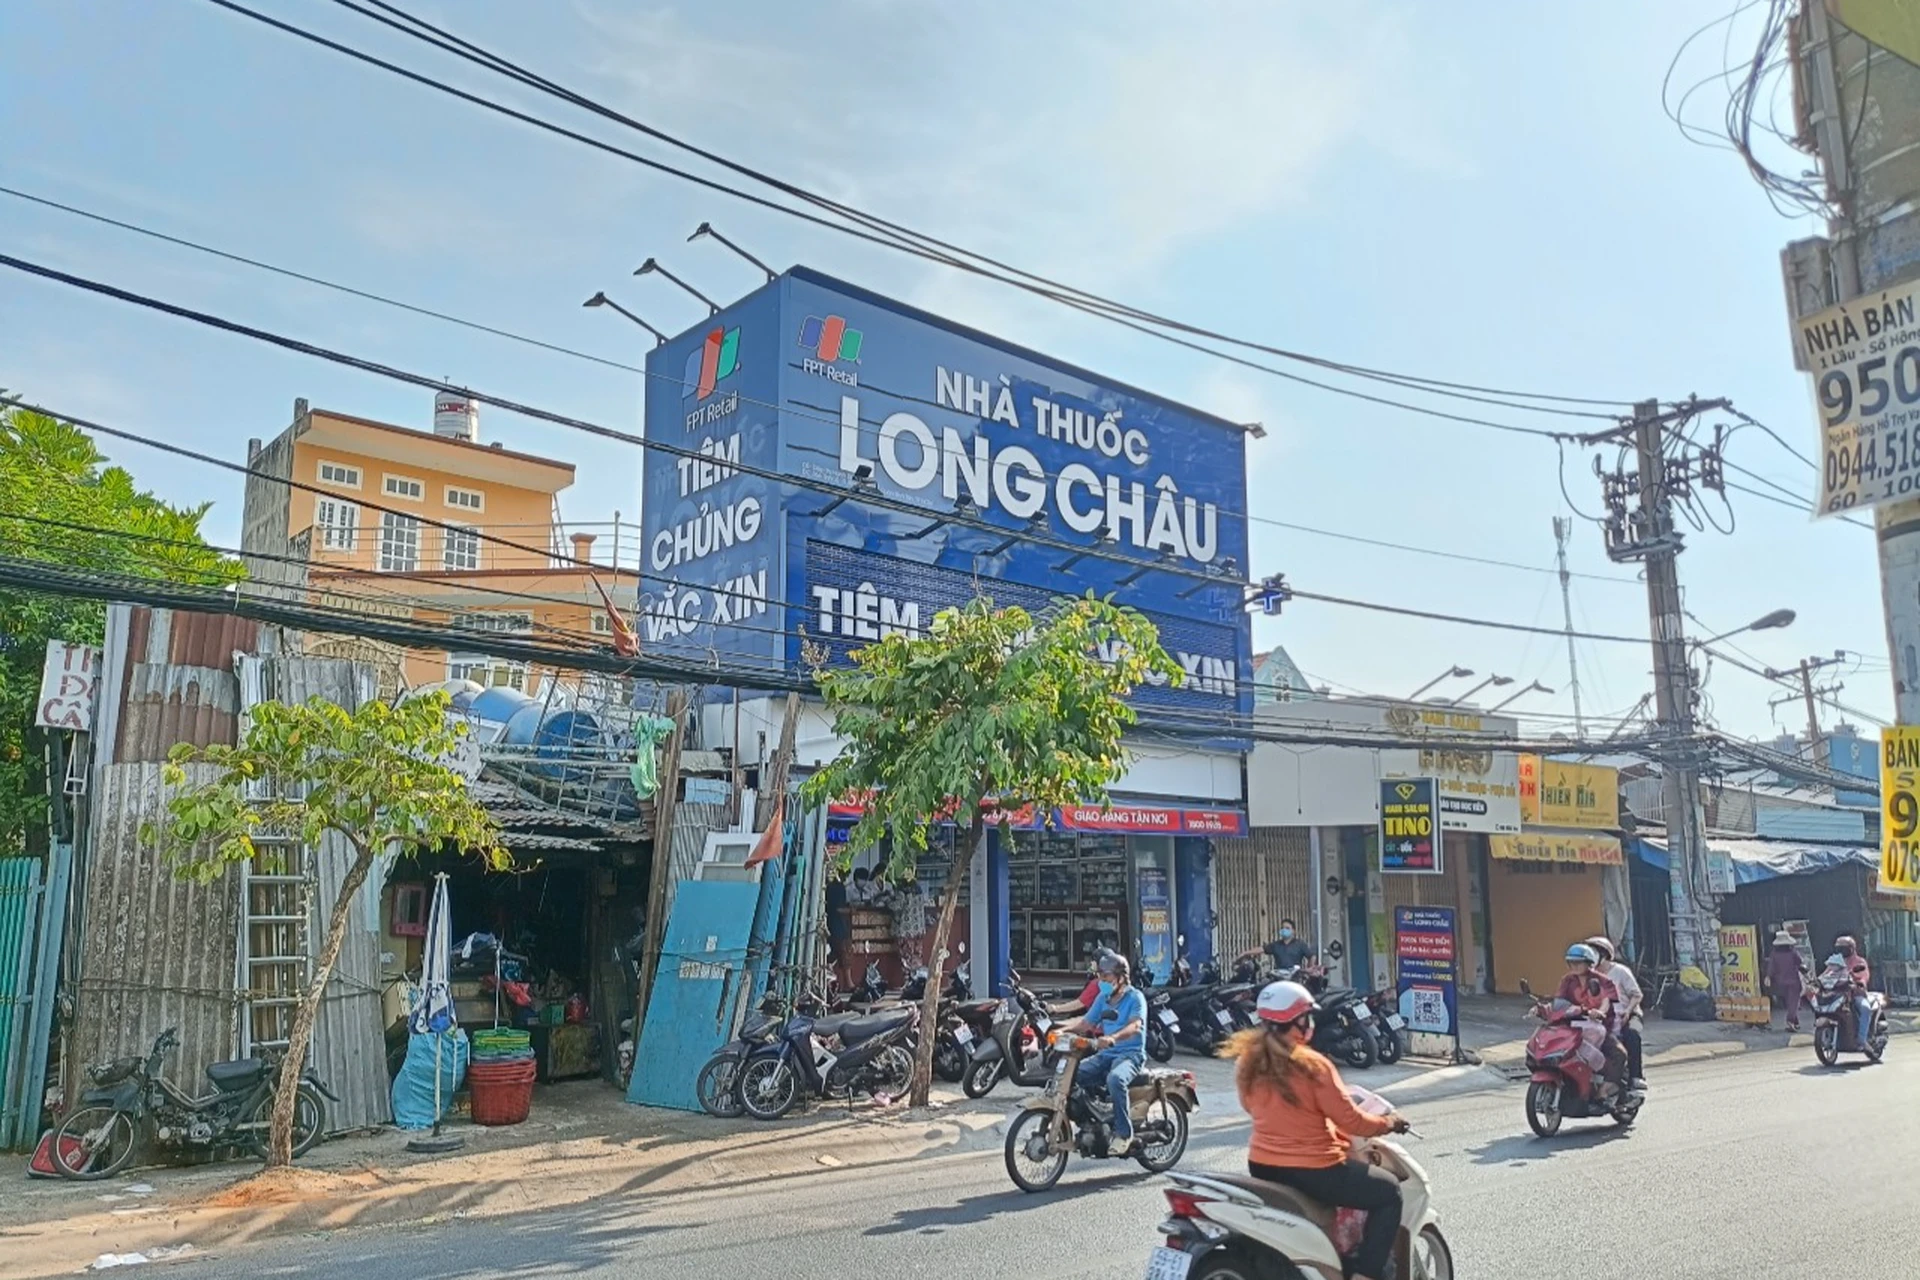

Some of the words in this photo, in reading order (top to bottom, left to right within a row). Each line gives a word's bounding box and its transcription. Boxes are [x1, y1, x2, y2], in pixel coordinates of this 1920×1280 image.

[1804, 306, 1860, 355] NHÀ
[1863, 292, 1914, 337] BÁN
[803, 358, 825, 375] FPT
[827, 365, 858, 388] Retail
[1819, 346, 1920, 427] 950
[686, 407, 706, 434] FPT
[707, 390, 739, 424] Retail
[936, 365, 1019, 429] NHÀ
[1032, 397, 1150, 466] THUỐC
[678, 432, 742, 498] TIÊM
[840, 395, 1047, 519] LONG
[1055, 463, 1218, 563] CHÂU
[1828, 490, 1857, 513] 60
[651, 496, 762, 572] CHỦNG
[646, 574, 702, 642] VẮC
[711, 568, 767, 626] XIN
[812, 581, 920, 641] TIÊM
[1177, 651, 1236, 697] XIN
[1885, 729, 1920, 768] BÁN
[1074, 811, 1100, 824] GIAO
[1383, 816, 1432, 836] TINO
